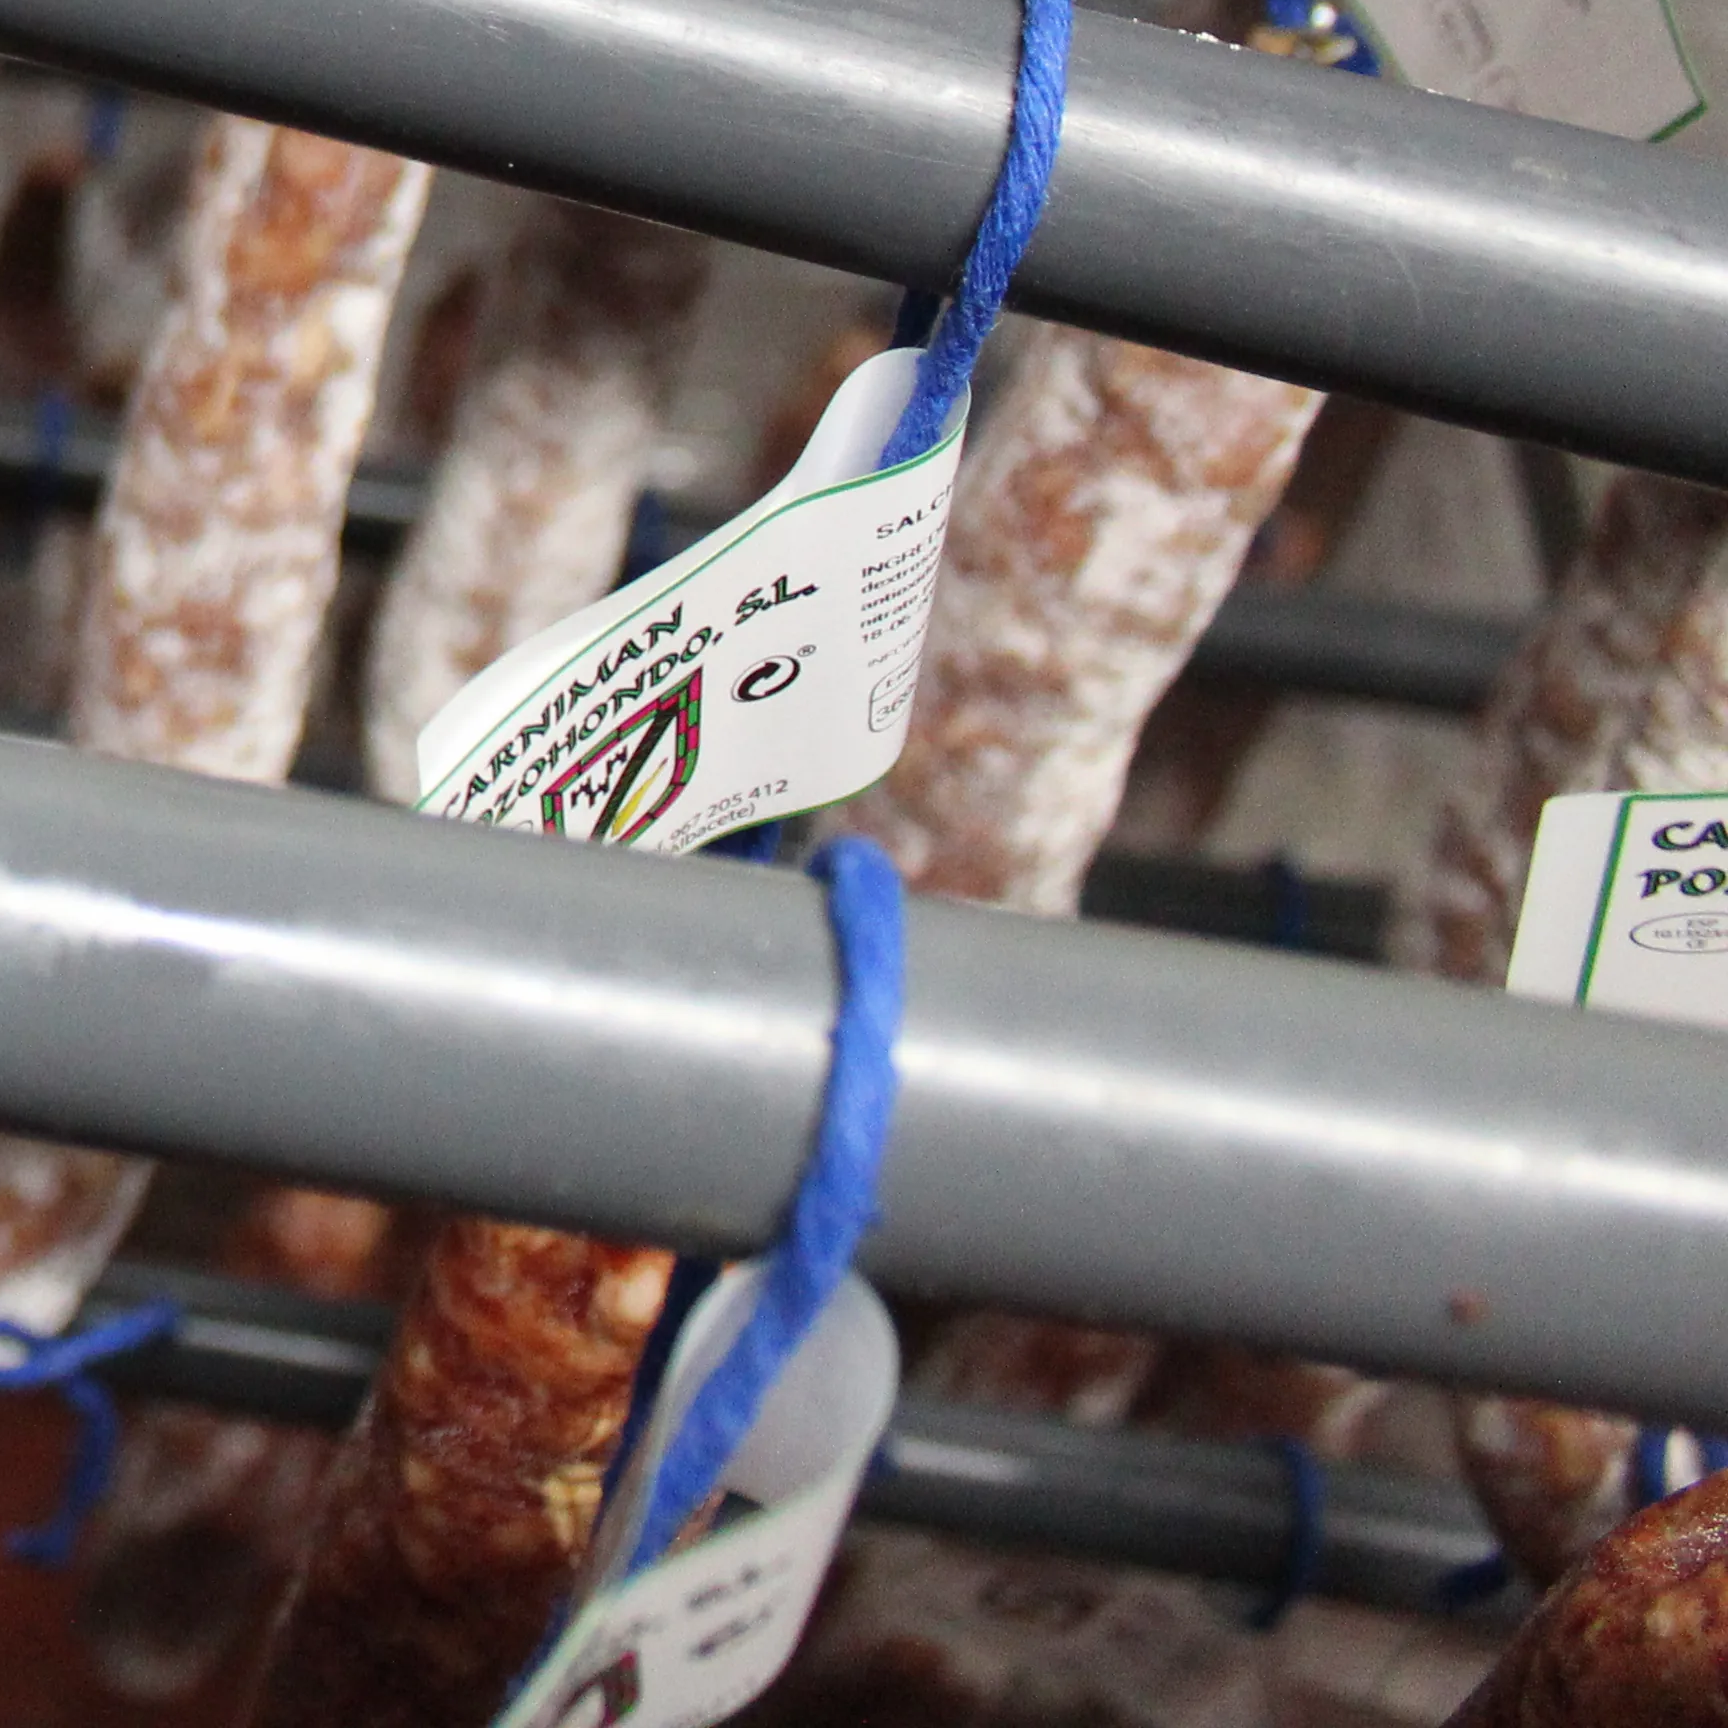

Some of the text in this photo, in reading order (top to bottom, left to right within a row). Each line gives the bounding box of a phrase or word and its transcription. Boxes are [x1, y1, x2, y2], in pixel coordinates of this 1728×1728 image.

[734, 573, 821, 626] S.L.
[707, 791, 743, 819] 205
[748, 779, 789, 800] 412
